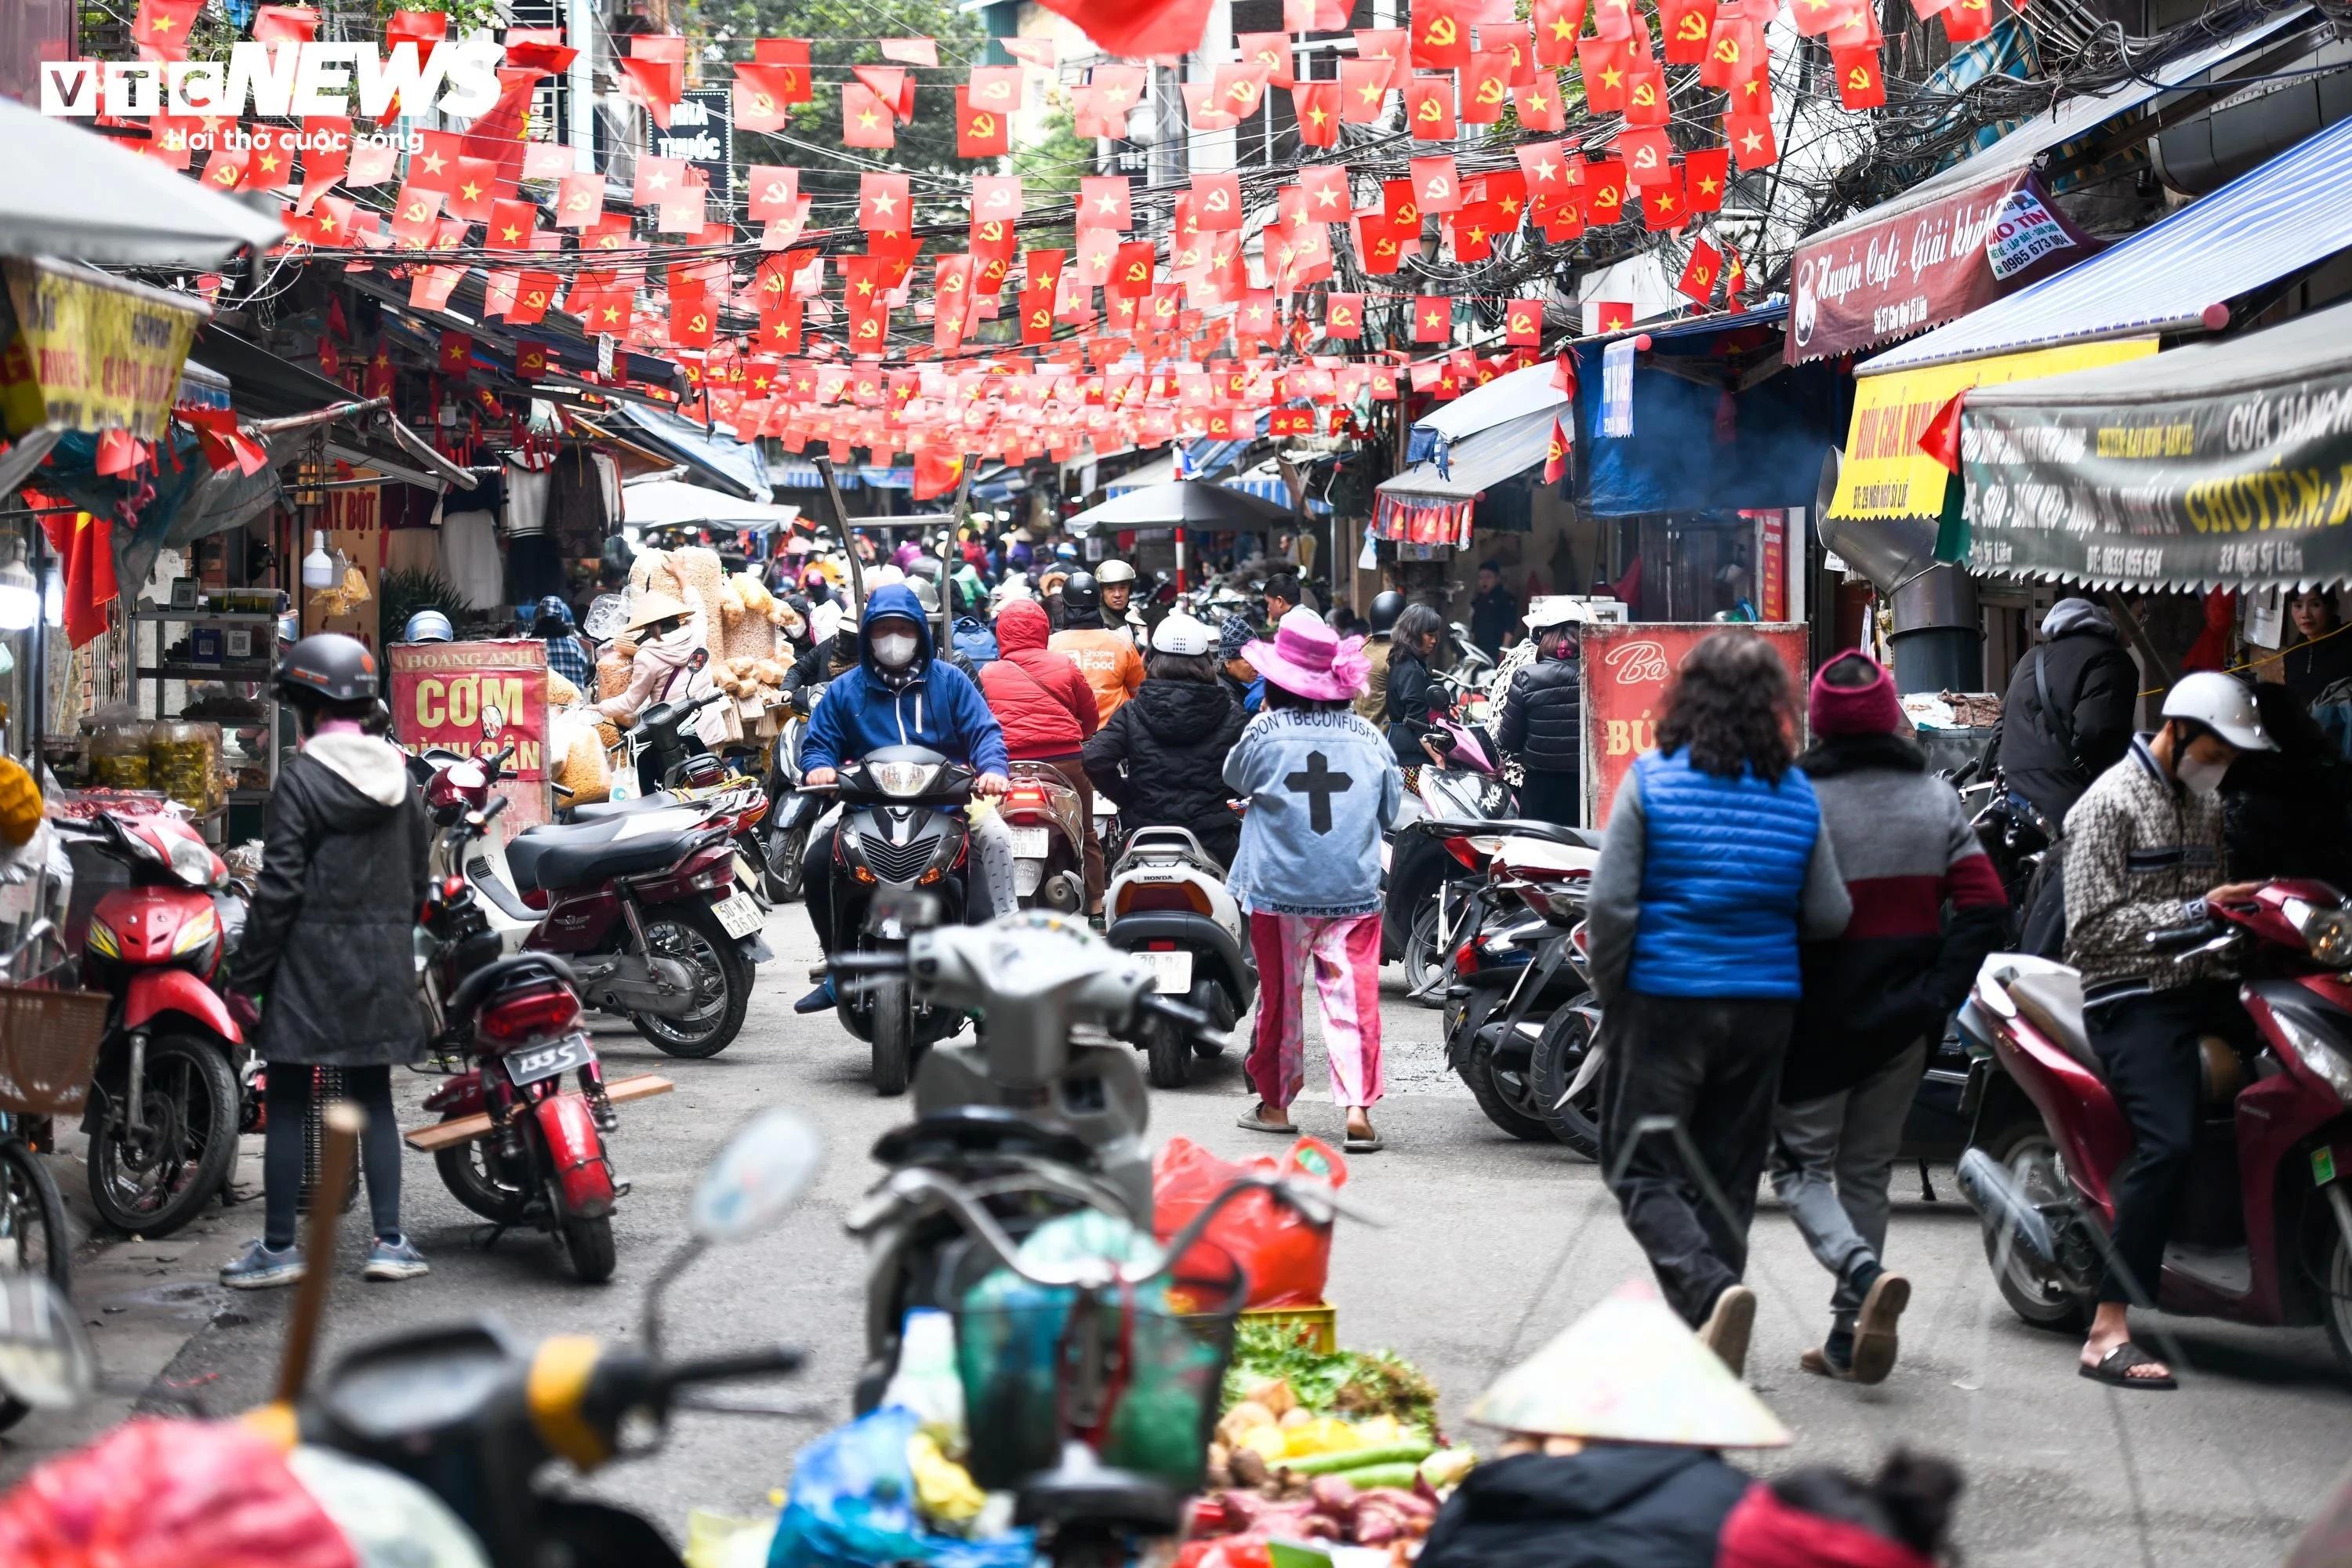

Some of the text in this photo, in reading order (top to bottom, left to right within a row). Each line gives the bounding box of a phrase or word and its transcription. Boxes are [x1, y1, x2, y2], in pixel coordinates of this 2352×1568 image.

[658, 129, 720, 160] THUỐC
[2013, 209, 2051, 230] TÍN
[1817, 246, 1861, 304] Huyền
[1866, 230, 1900, 291] Café
[1910, 218, 1948, 284] Giải
[2002, 234, 2070, 272] 0965 673 064
[1855, 397, 1881, 461] BÚN
[2185, 452, 2332, 534] CHUYÊN:
[346, 487, 376, 539] BỘT
[407, 651, 532, 668] HOÀNG ANH
[1083, 649, 1115, 659] Shopee
[1083, 659, 1115, 670] Food
[416, 673, 524, 728] CƠM
[1272, 902, 1295, 914] BACK
[1297, 906, 1306, 916] UP
[1312, 906, 1327, 916] THE
[1330, 906, 1356, 916] HEAVY
